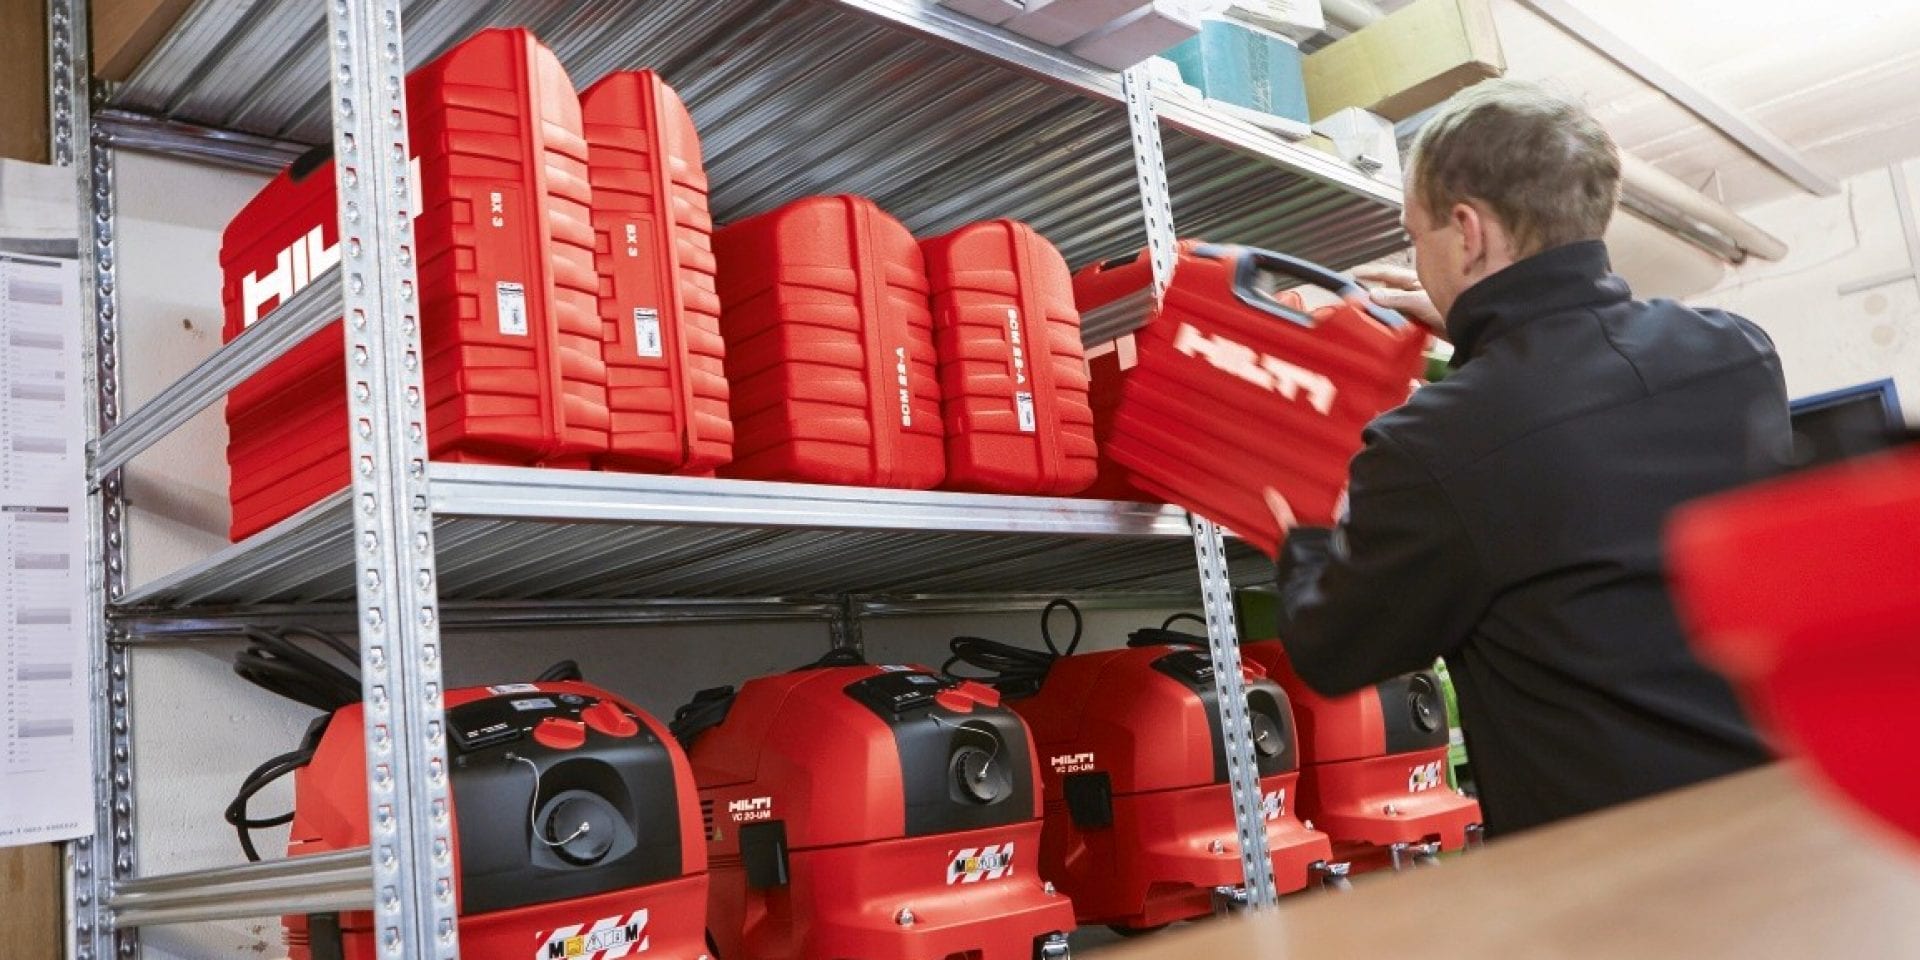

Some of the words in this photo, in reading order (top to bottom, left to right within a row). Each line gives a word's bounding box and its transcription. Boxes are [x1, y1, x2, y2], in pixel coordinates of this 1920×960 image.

[490, 192, 503, 213] BX
[492, 216, 504, 227] 3
[625, 224, 637, 244] BX
[1051, 752, 1094, 766] HILTI
[728, 796, 771, 813] HILTI
[731, 812, 743, 822] VC
[548, 940, 565, 959] M
[624, 922, 638, 942] M
